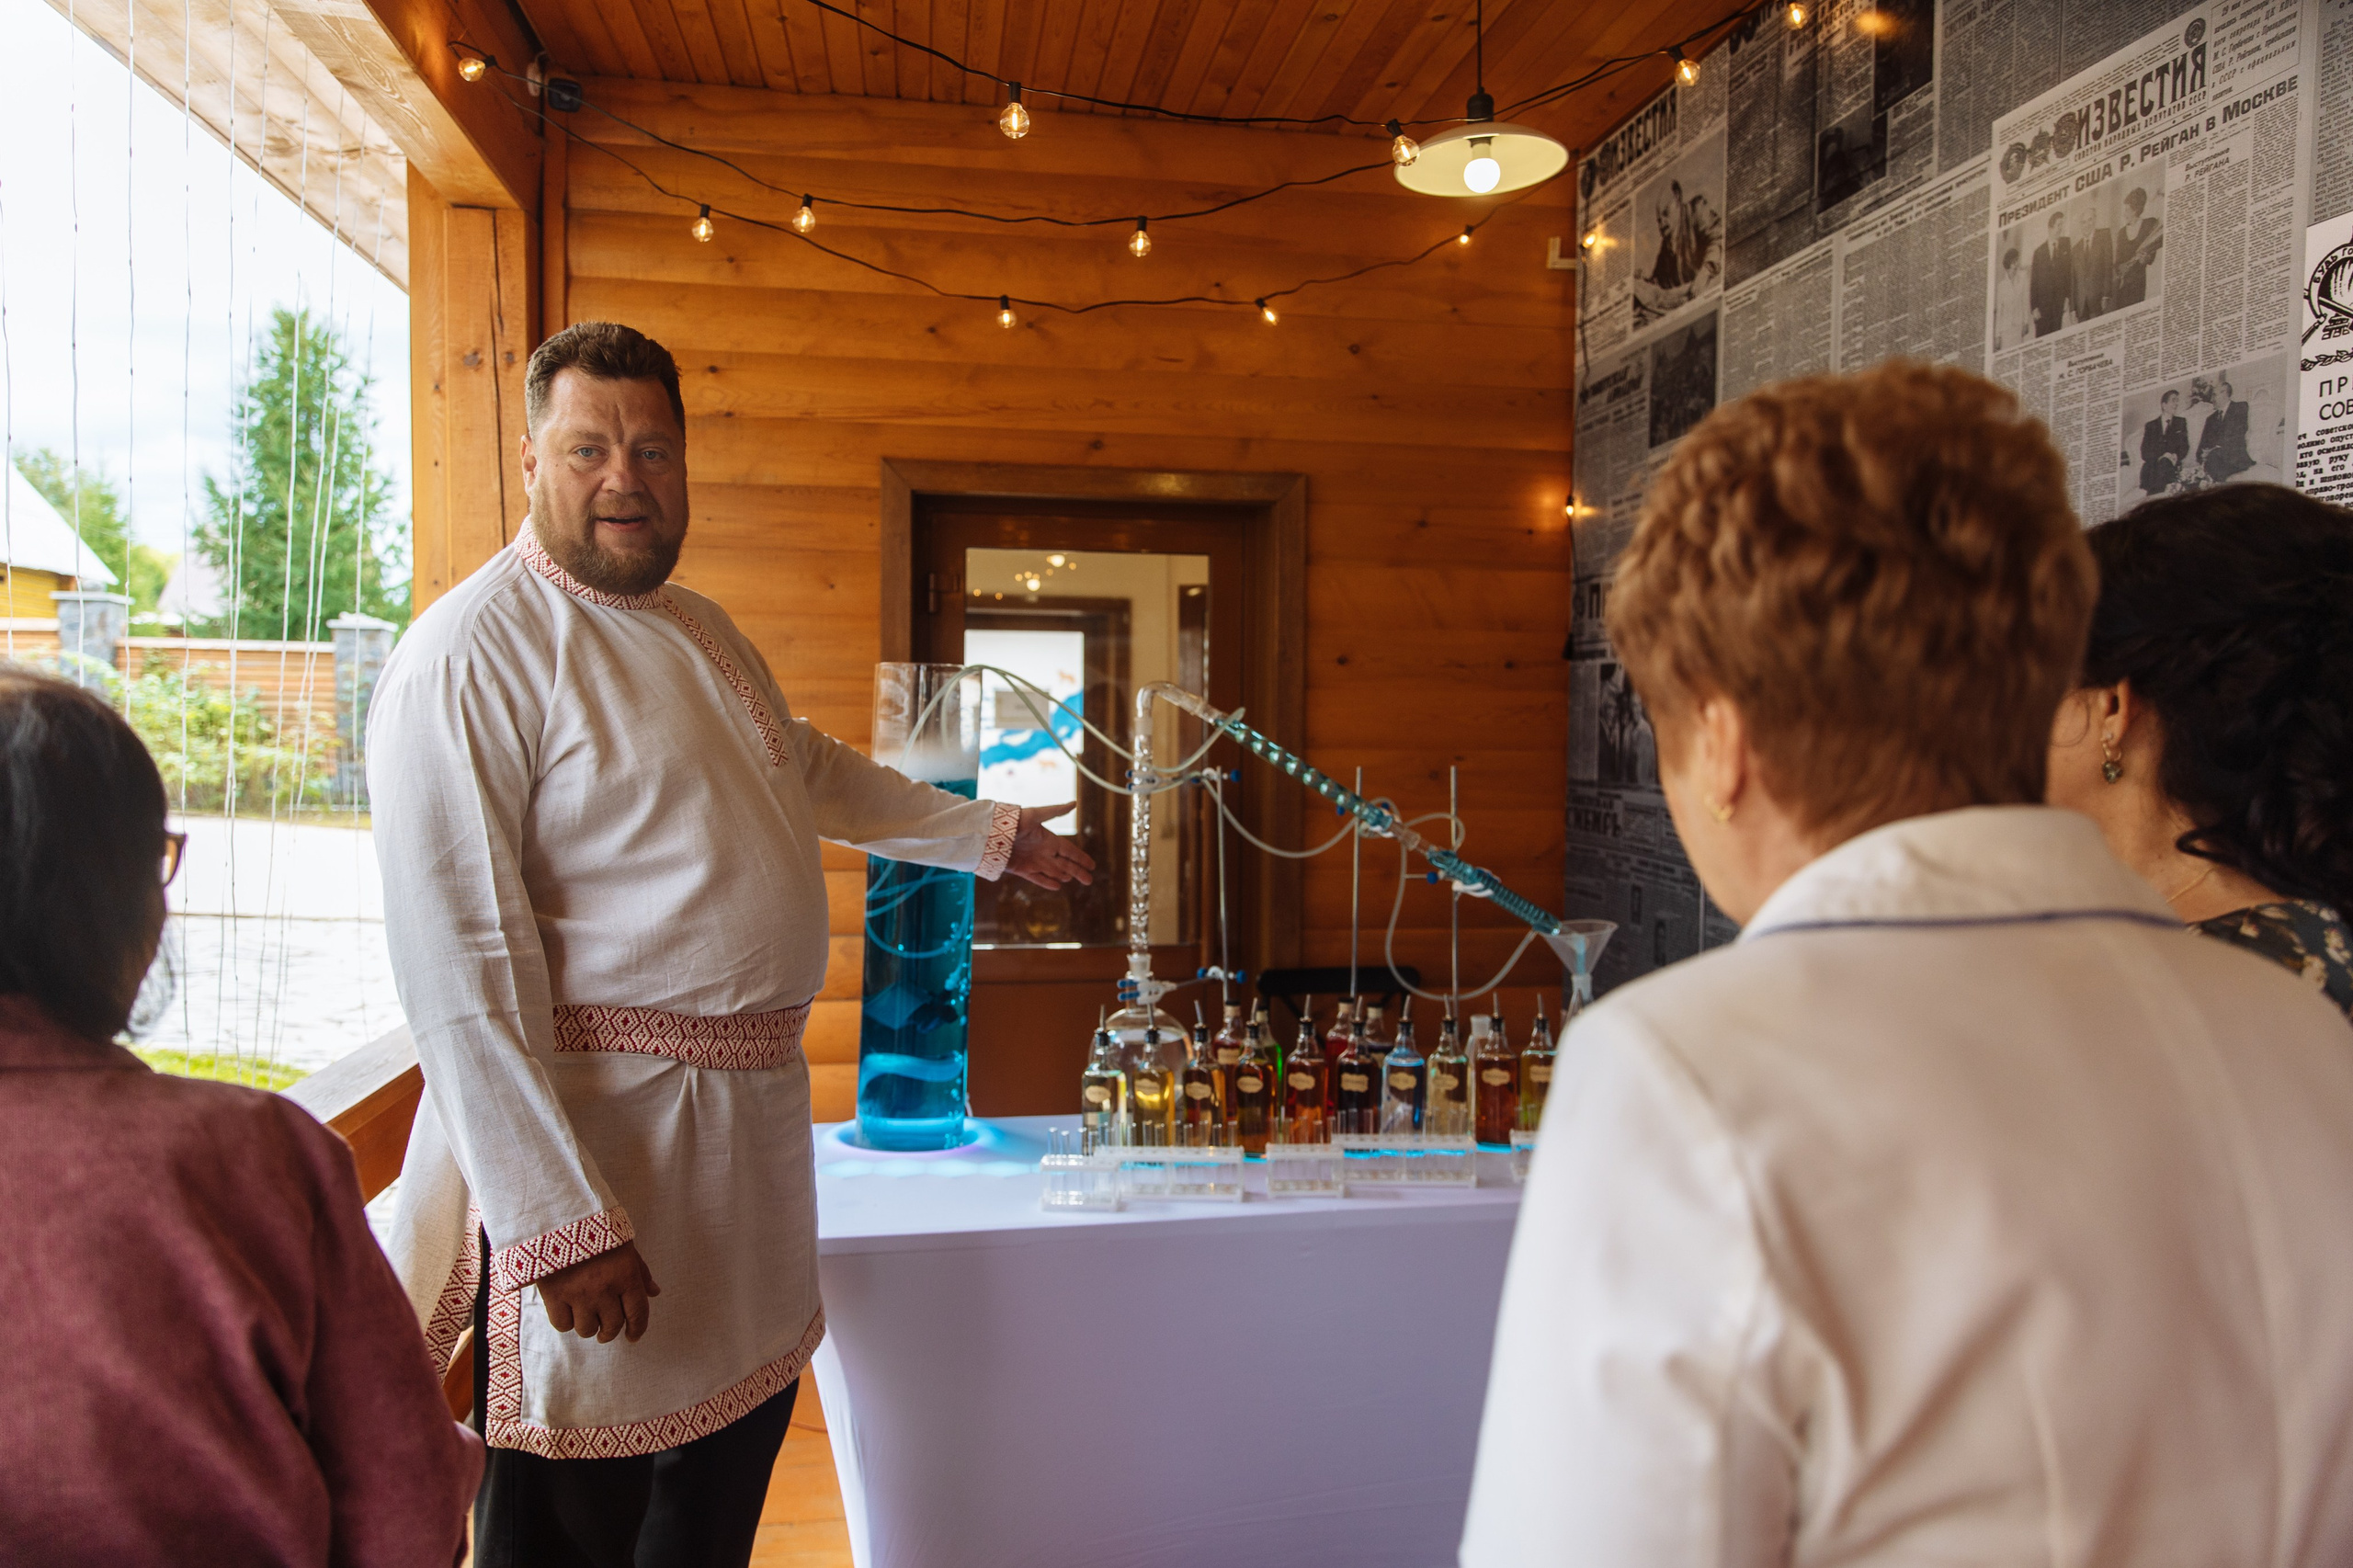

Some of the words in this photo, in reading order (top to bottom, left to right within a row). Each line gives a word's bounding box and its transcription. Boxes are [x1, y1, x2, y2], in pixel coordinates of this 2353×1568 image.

[2076, 40, 2208, 150] ИЗВЕСТИЯ
[2188, 90, 2207, 107] СССР
[2075, 163, 2112, 193] США
[2120, 153, 2135, 172] Р.
[2194, 156, 2230, 178] РЕЙГАНА
[2312, 255, 2338, 284] БУДЬ
[2319, 376, 2353, 398] ПР
[2315, 423, 2353, 437] советско
[2329, 453, 2349, 465] руку
[2331, 463, 2345, 472] его
[2320, 472, 2353, 483] шпионо
